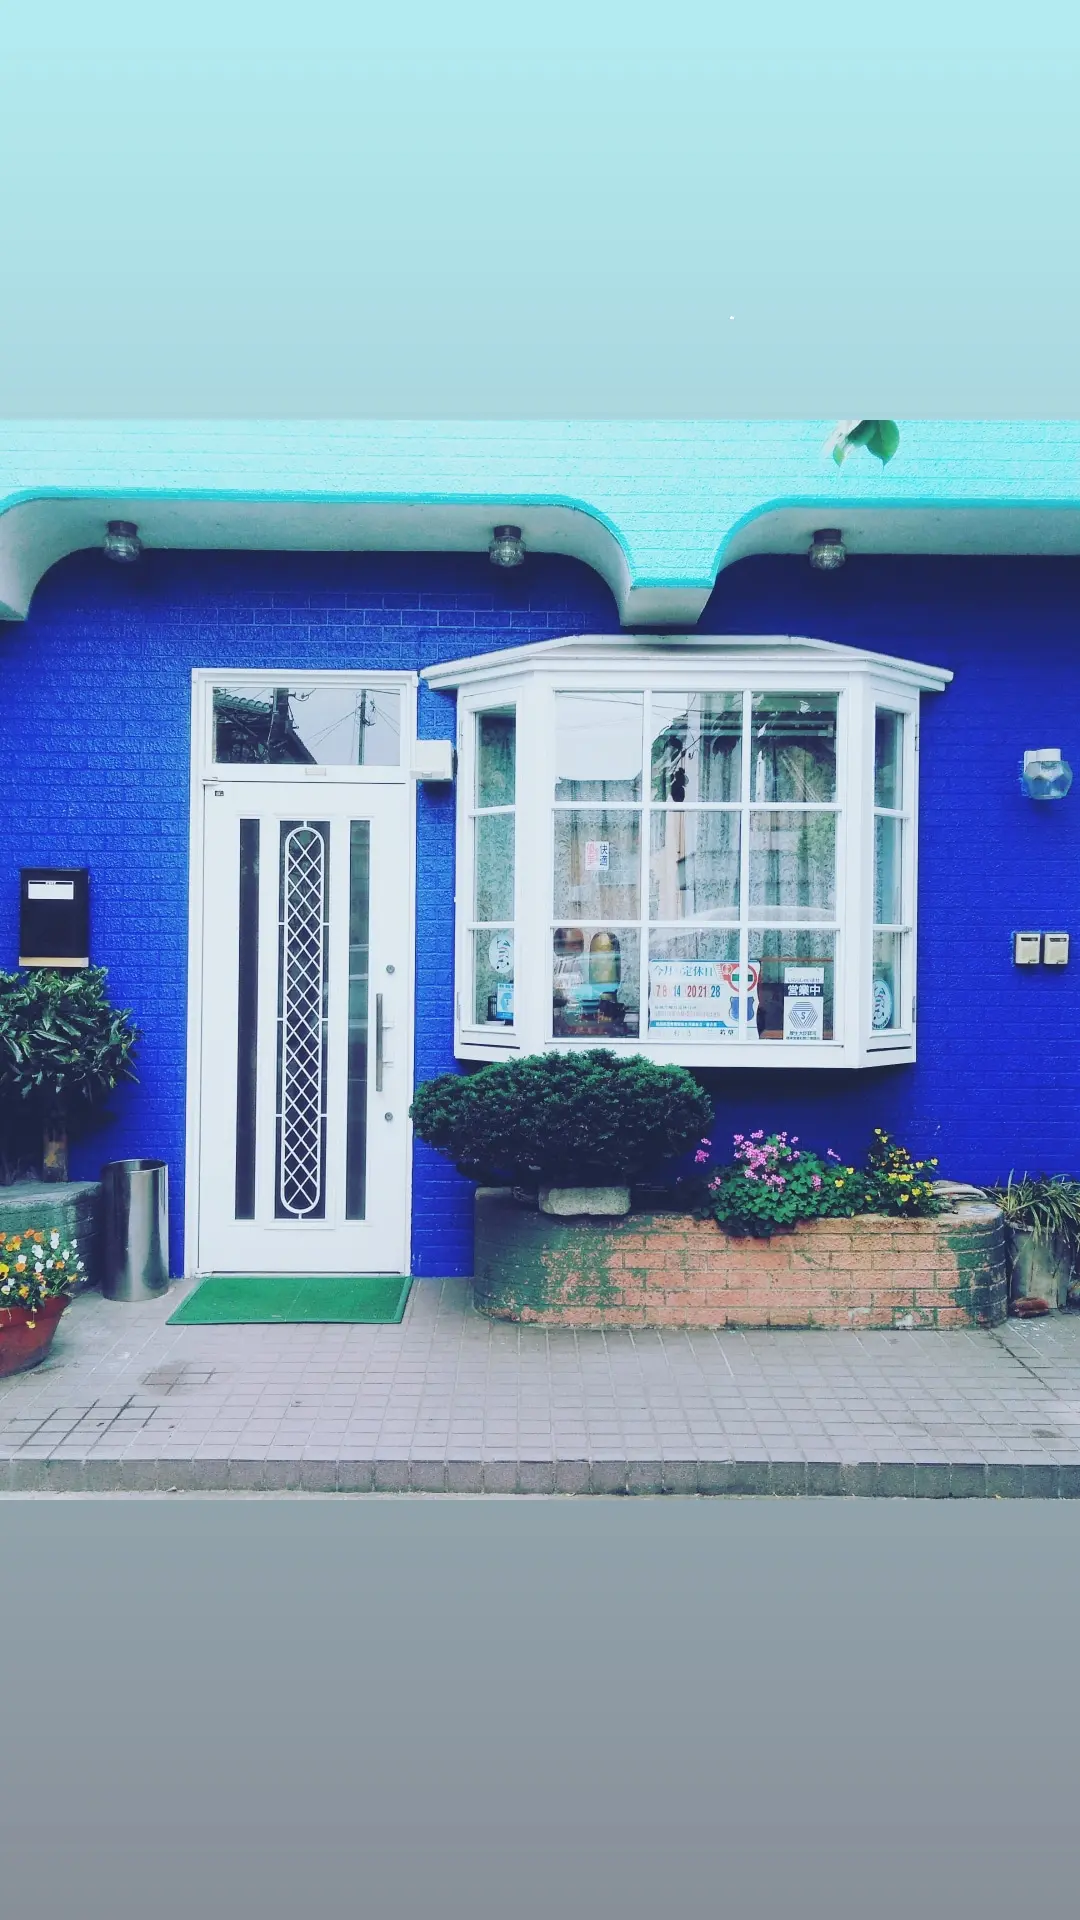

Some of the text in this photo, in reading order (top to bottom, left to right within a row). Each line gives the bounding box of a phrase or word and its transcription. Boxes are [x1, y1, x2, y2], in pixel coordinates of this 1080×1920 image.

[654, 965, 713, 977] 今月定休日
[687, 984, 697, 997] 20
[698, 984, 707, 997] 21
[711, 984, 721, 997] 28
[787, 984, 821, 996] 営業中
